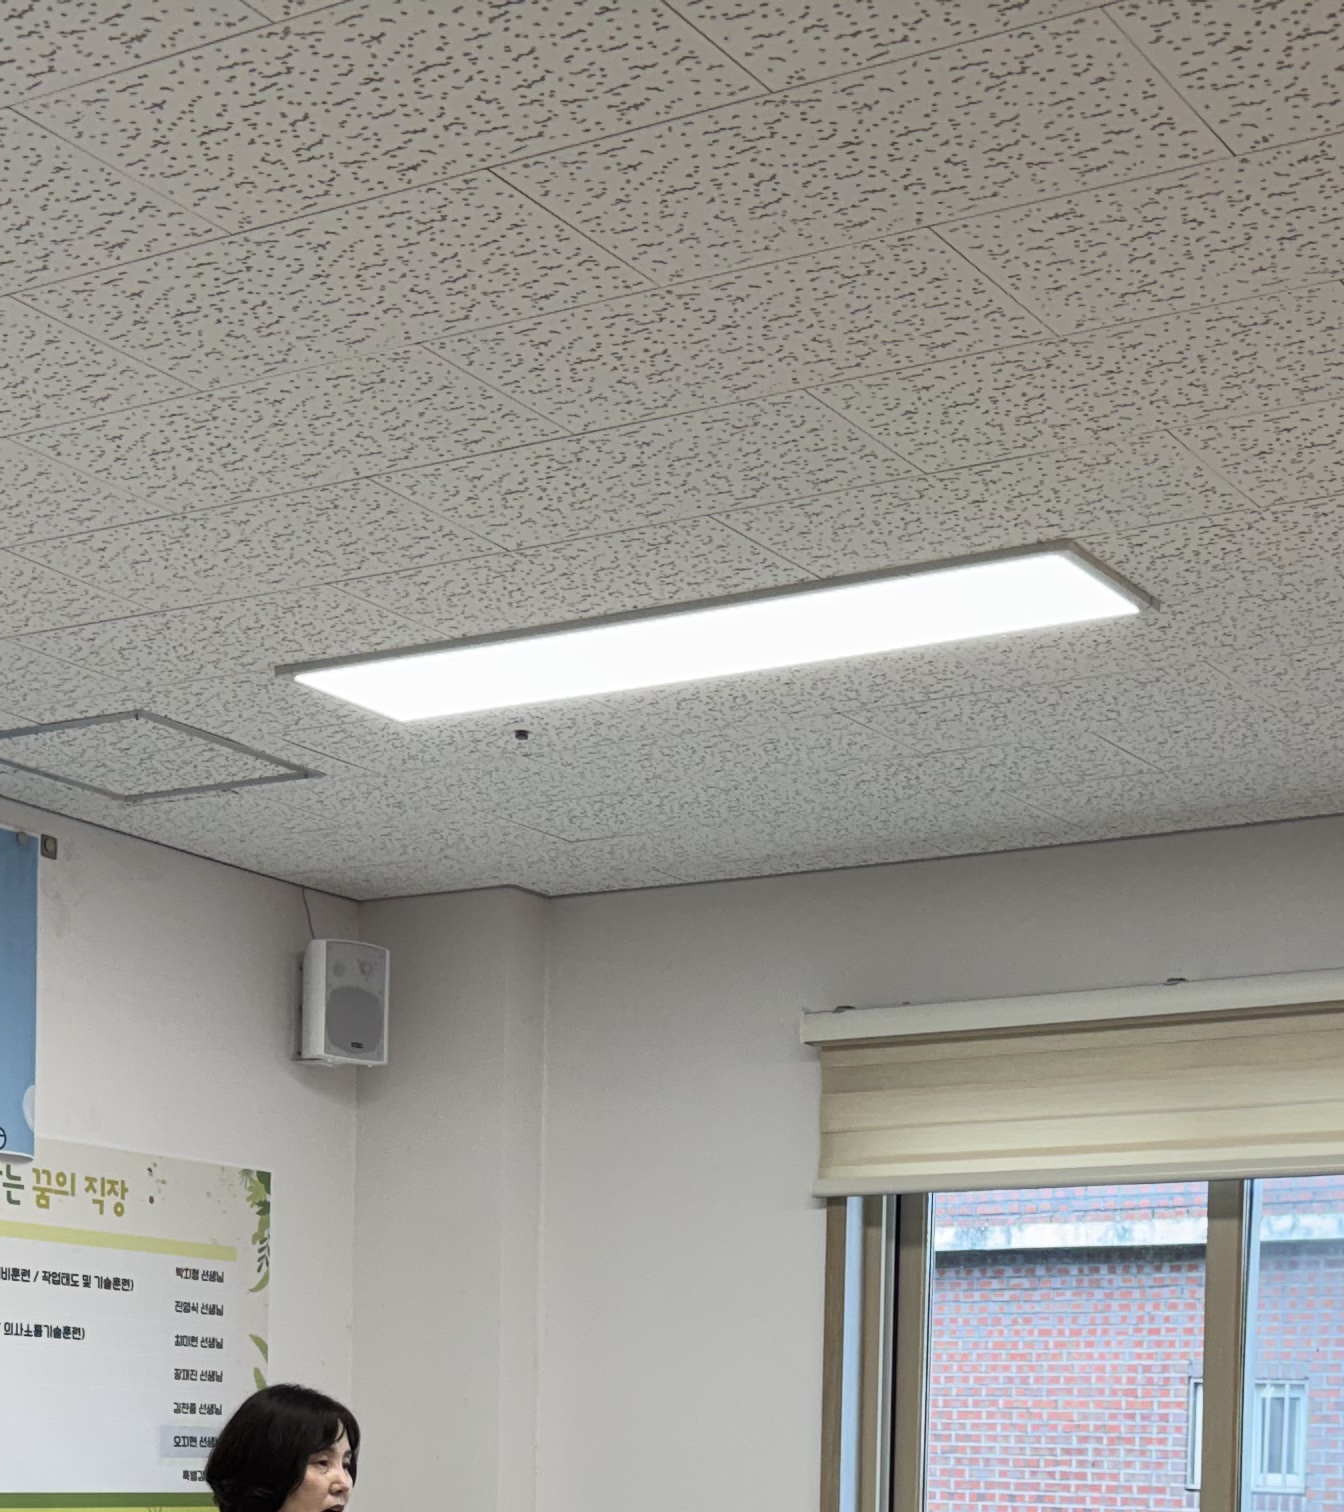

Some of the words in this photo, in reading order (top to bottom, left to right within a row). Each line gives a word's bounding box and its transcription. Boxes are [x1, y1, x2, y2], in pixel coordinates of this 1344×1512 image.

[32, 1167, 76, 1209] 꿈의
[84, 1176, 129, 1217] 직장
[41, 1270, 80, 1288] 작업태도
[94, 1275, 134, 1292] 기술훈련)
[4, 1321, 85, 1340] 의사소통기술훈련)
[199, 1435, 219, 1448] 선생
